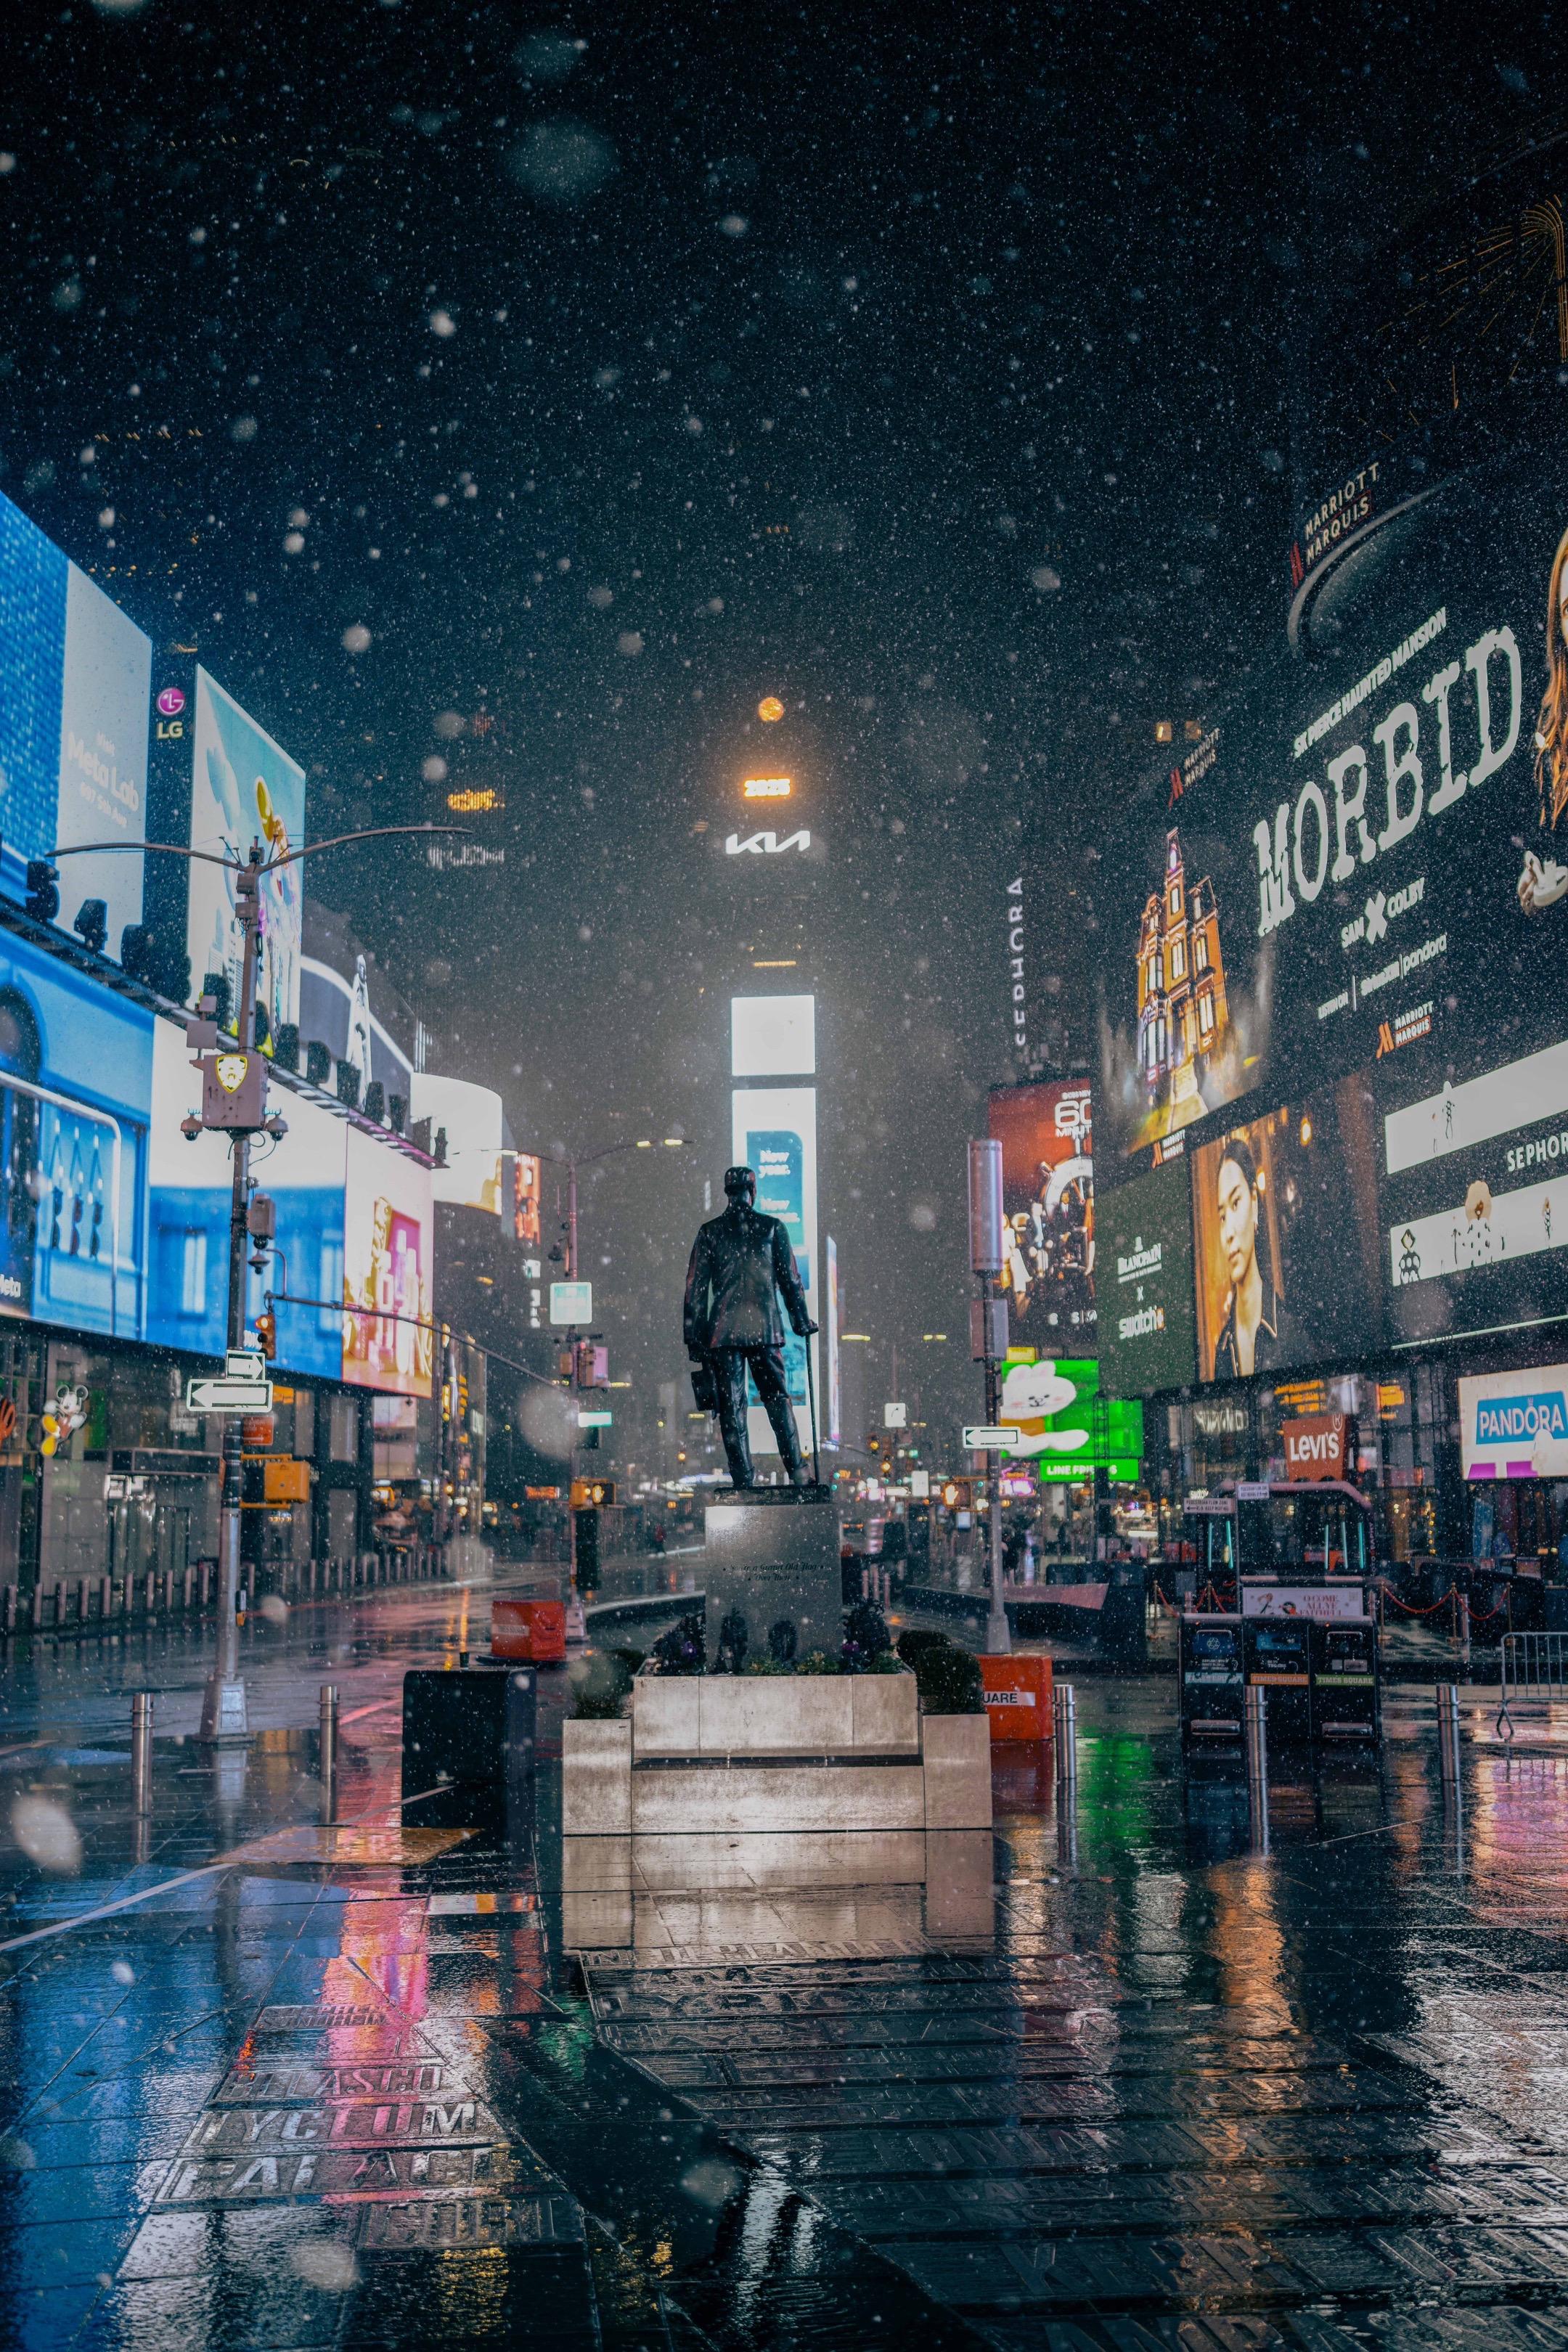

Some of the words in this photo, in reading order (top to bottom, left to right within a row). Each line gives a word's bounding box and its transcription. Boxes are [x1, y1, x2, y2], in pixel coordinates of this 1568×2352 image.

[1304, 462, 1379, 540] MARRIOTT
[1307, 497, 1370, 565] MARQUIS
[1342, 658, 1392, 717] HAUNTED
[1392, 606, 1447, 671] MANSION
[157, 721, 184, 740] LG
[68, 730, 109, 789] Meta
[111, 766, 139, 812] Lab
[1253, 625, 1523, 937] MORBID
[1341, 916, 1365, 949] SAM
[1365, 890, 1388, 944] X
[1387, 877, 1425, 918] COLBY
[1402, 932, 1447, 976] pandora
[1395, 1000, 1434, 1031] MARRIOTT
[1396, 1018, 1430, 1046] MARQUIS
[1479, 1404, 1565, 1439] PANDORA
[1046, 1465, 1071, 1476] LINE
[1072, 1464, 1118, 1475] FRIES
[1344, 1676, 1373, 1685] SQUARE
[197, 2102, 479, 2146] LYCEUM
